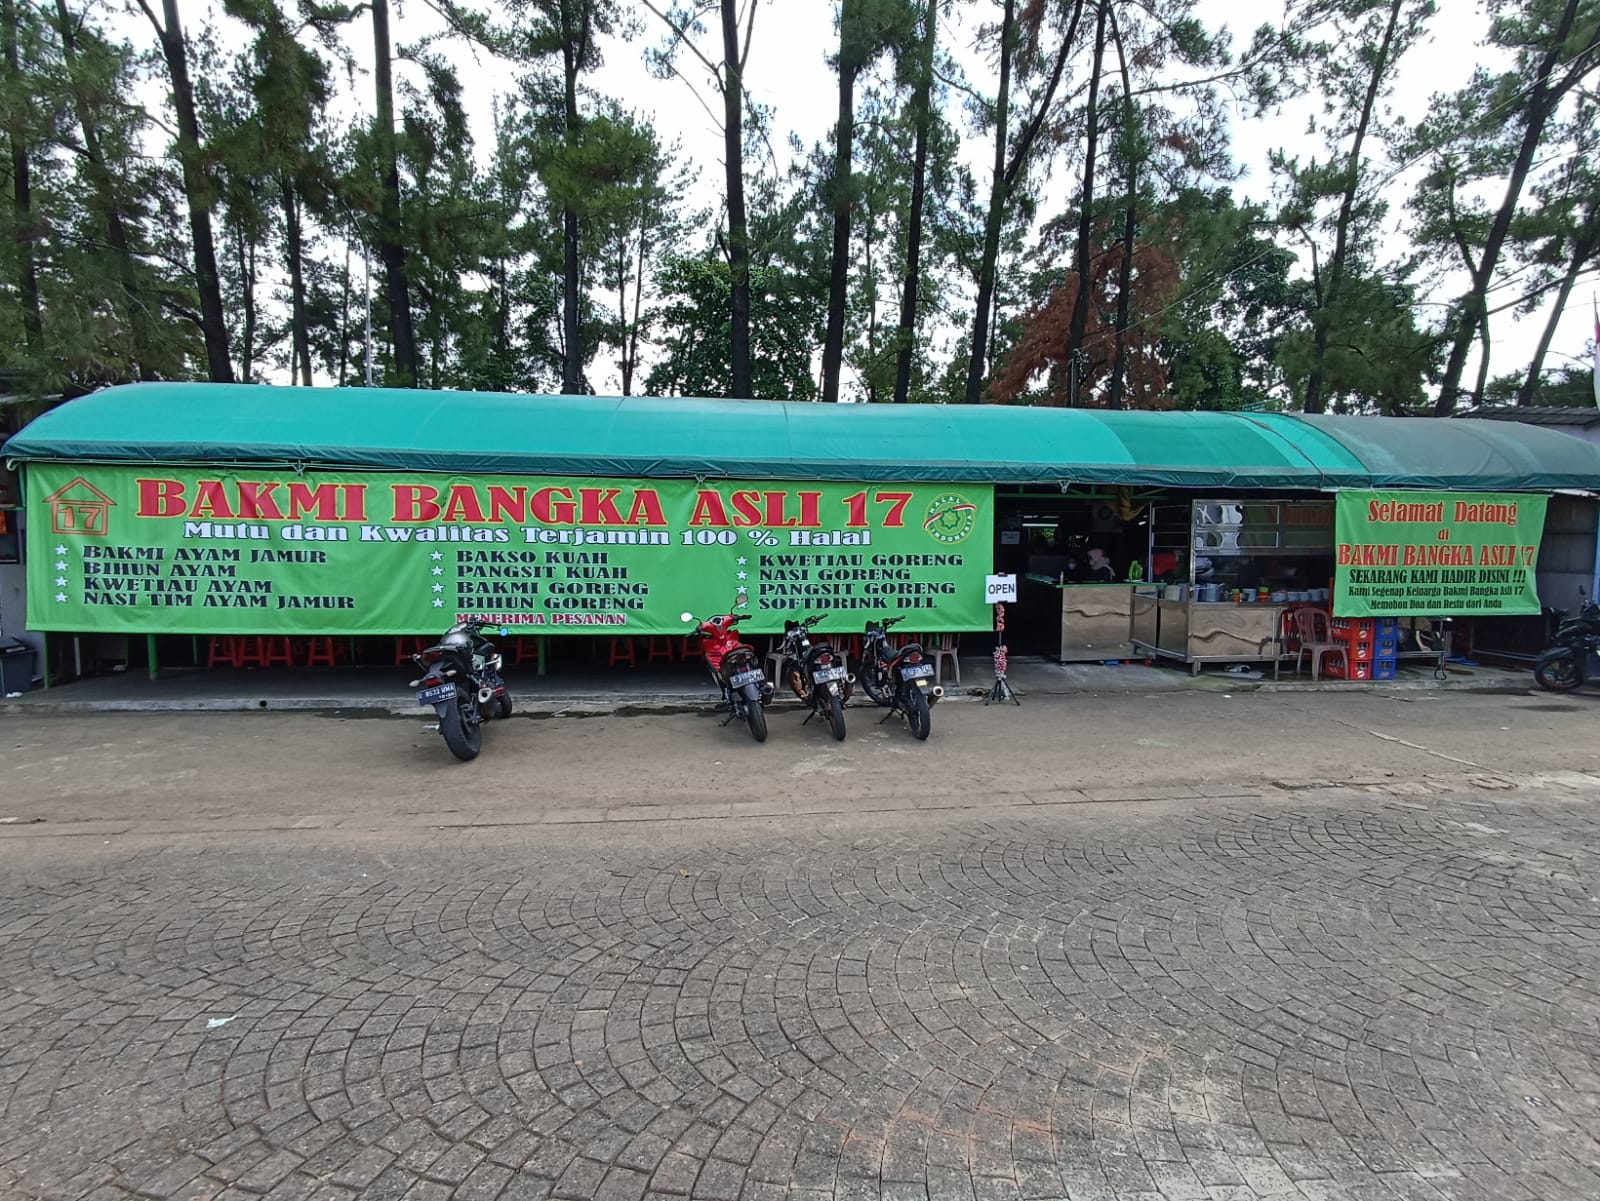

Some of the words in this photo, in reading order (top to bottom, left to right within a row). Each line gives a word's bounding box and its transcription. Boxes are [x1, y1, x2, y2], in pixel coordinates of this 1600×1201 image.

[135, 477, 368, 522] BAKMI
[390, 483, 668, 526] BANGKA
[688, 489, 823, 528] ASLI
[842, 491, 914, 528] 17
[928, 496, 961, 514] HALAL
[58, 506, 101, 529] 17
[1368, 500, 1444, 523] Selamat
[1454, 501, 1518, 526] Datang
[183, 521, 270, 541] Mutu
[281, 521, 349, 541] dan
[359, 525, 510, 544] Kwalitas
[520, 527, 670, 546] Terjamin
[680, 529, 738, 546] 100
[748, 531, 779, 547] %
[788, 530, 872, 546] Halal
[930, 515, 972, 542] INDONESIA
[1437, 528, 1449, 541] di
[83, 545, 164, 561] BAKMI
[174, 548, 241, 562] AYAM
[250, 548, 327, 564] JAMUR
[456, 550, 537, 563] BAKSO
[545, 551, 608, 564] KUAH
[759, 554, 863, 567] KWETIAU
[871, 554, 964, 567] GORENG
[1338, 543, 1399, 567] BAKMI
[1403, 544, 1474, 567] BANGKA
[1479, 544, 1517, 567] ASLI
[83, 561, 161, 576] BIHUN
[170, 563, 237, 577] AYAM
[456, 565, 557, 579] PANGSIT
[566, 566, 628, 579] KUAH
[759, 568, 810, 581] NASI
[818, 569, 911, 581] GORENG
[1349, 569, 1407, 583] SEKARANG
[1411, 569, 1438, 583] KAMI
[1441, 569, 1476, 583] HADIR
[1479, 569, 1510, 583] DISINI
[83, 577, 199, 593] KWETIAU
[208, 579, 273, 594] AYAM
[456, 581, 539, 594] BAKMI
[549, 581, 649, 595] GORENG
[759, 583, 857, 596] PANGSIT
[864, 583, 956, 595] GORENG
[988, 583, 1015, 595] OPEN
[1349, 586, 1370, 596] Kami
[1371, 587, 1404, 598] Segenap
[1406, 587, 1440, 597] Keluarga
[1443, 586, 1468, 596] Bakmi
[1470, 586, 1498, 596] Bangka
[1500, 586, 1512, 595] Asli
[1514, 586, 1524, 595] 17
[83, 592, 138, 606] NASI
[146, 593, 193, 607] TIM
[202, 594, 268, 608] AYAM
[275, 595, 355, 610] JAMUR
[456, 596, 534, 609] BIHUN
[544, 597, 645, 610] GORENG
[759, 597, 889, 610] SOFTDRINK
[896, 597, 938, 609] DLL
[1370, 600, 1407, 609] Memohon
[1410, 600, 1425, 609] Doa
[1427, 600, 1441, 609] dan
[1444, 600, 1464, 609] Restu
[1466, 600, 1481, 609] dari
[1484, 600, 1502, 609] Anda
[456, 613, 545, 625] MENERIMA
[551, 613, 626, 625] PESANAN
